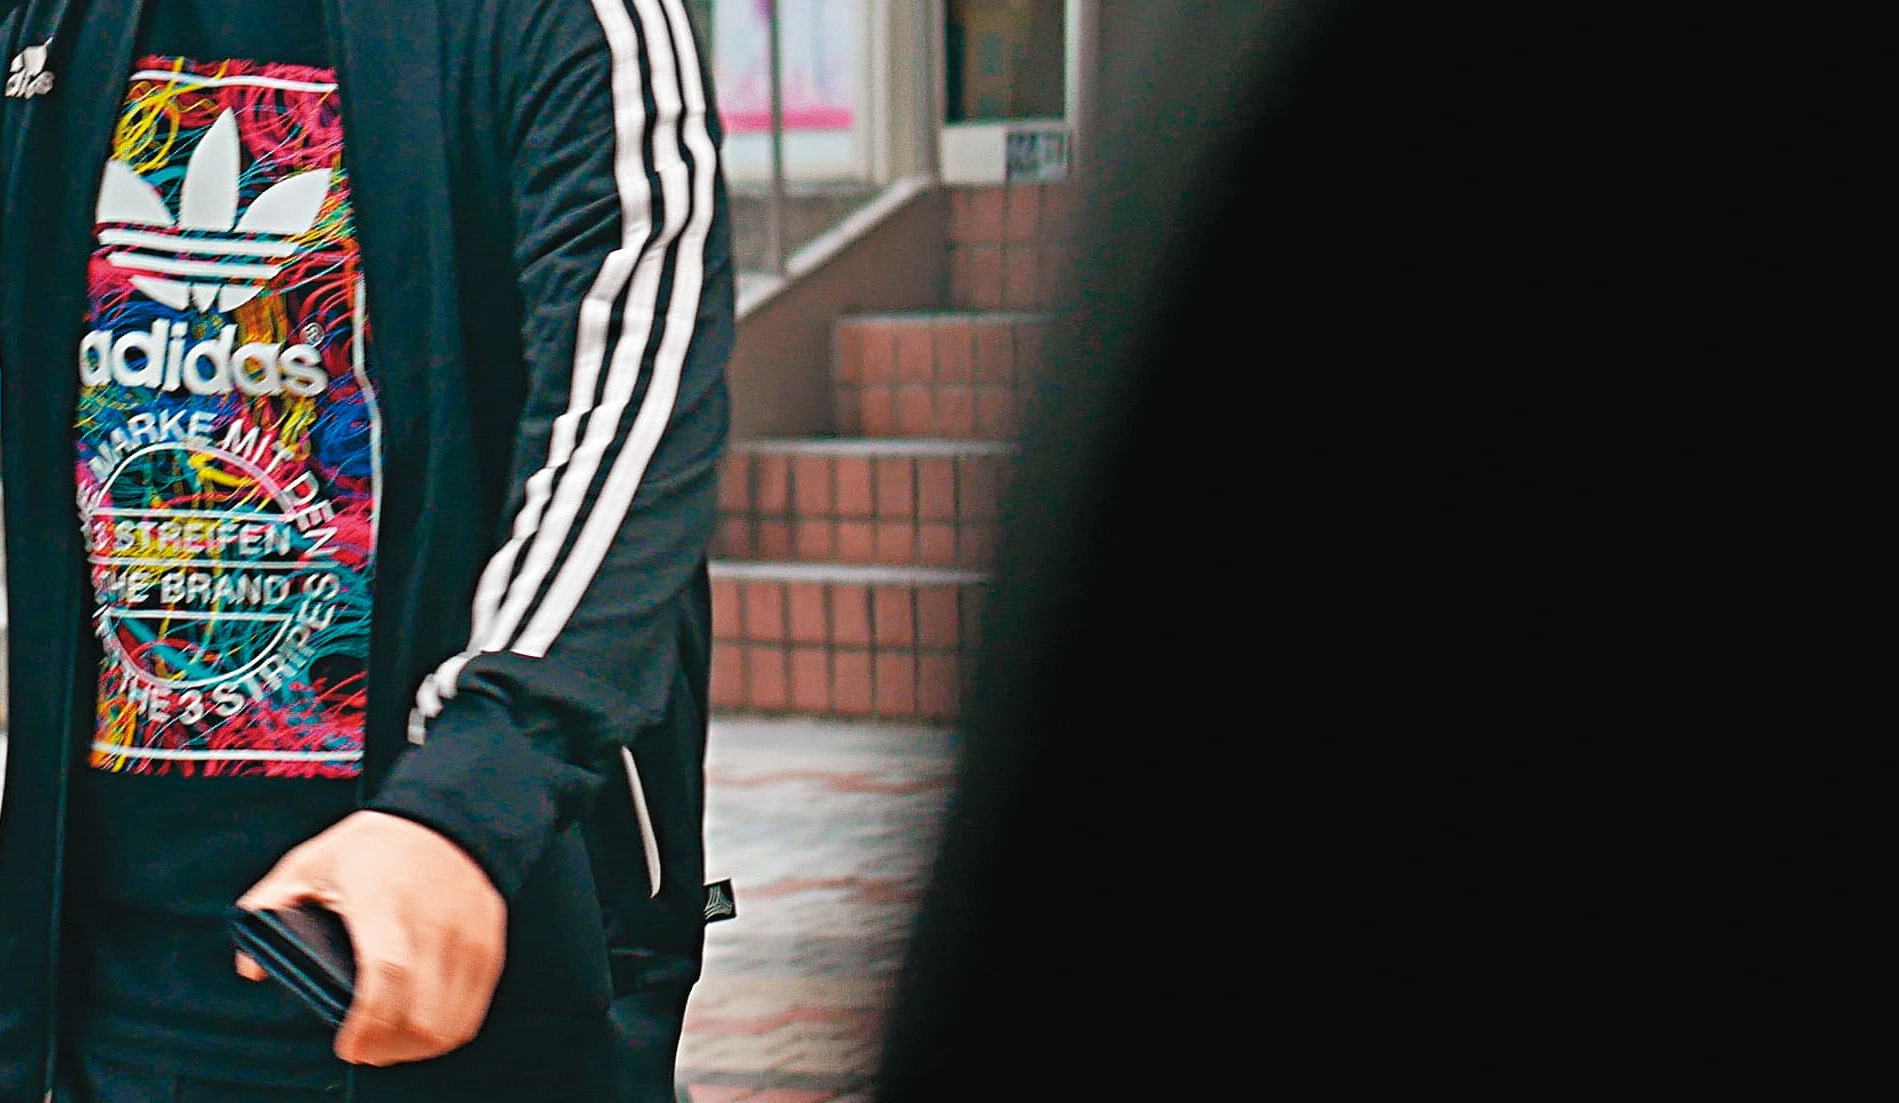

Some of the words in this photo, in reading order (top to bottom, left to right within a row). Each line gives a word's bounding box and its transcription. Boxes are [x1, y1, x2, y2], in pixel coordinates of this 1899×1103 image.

[80, 318, 328, 397] adidas
[87, 409, 218, 482] MARKE
[219, 418, 295, 475] MIT
[280, 470, 342, 557] DEN
[114, 519, 291, 556] STREIFEN
[160, 572, 290, 605] BRAND
[178, 689, 205, 726] 3
